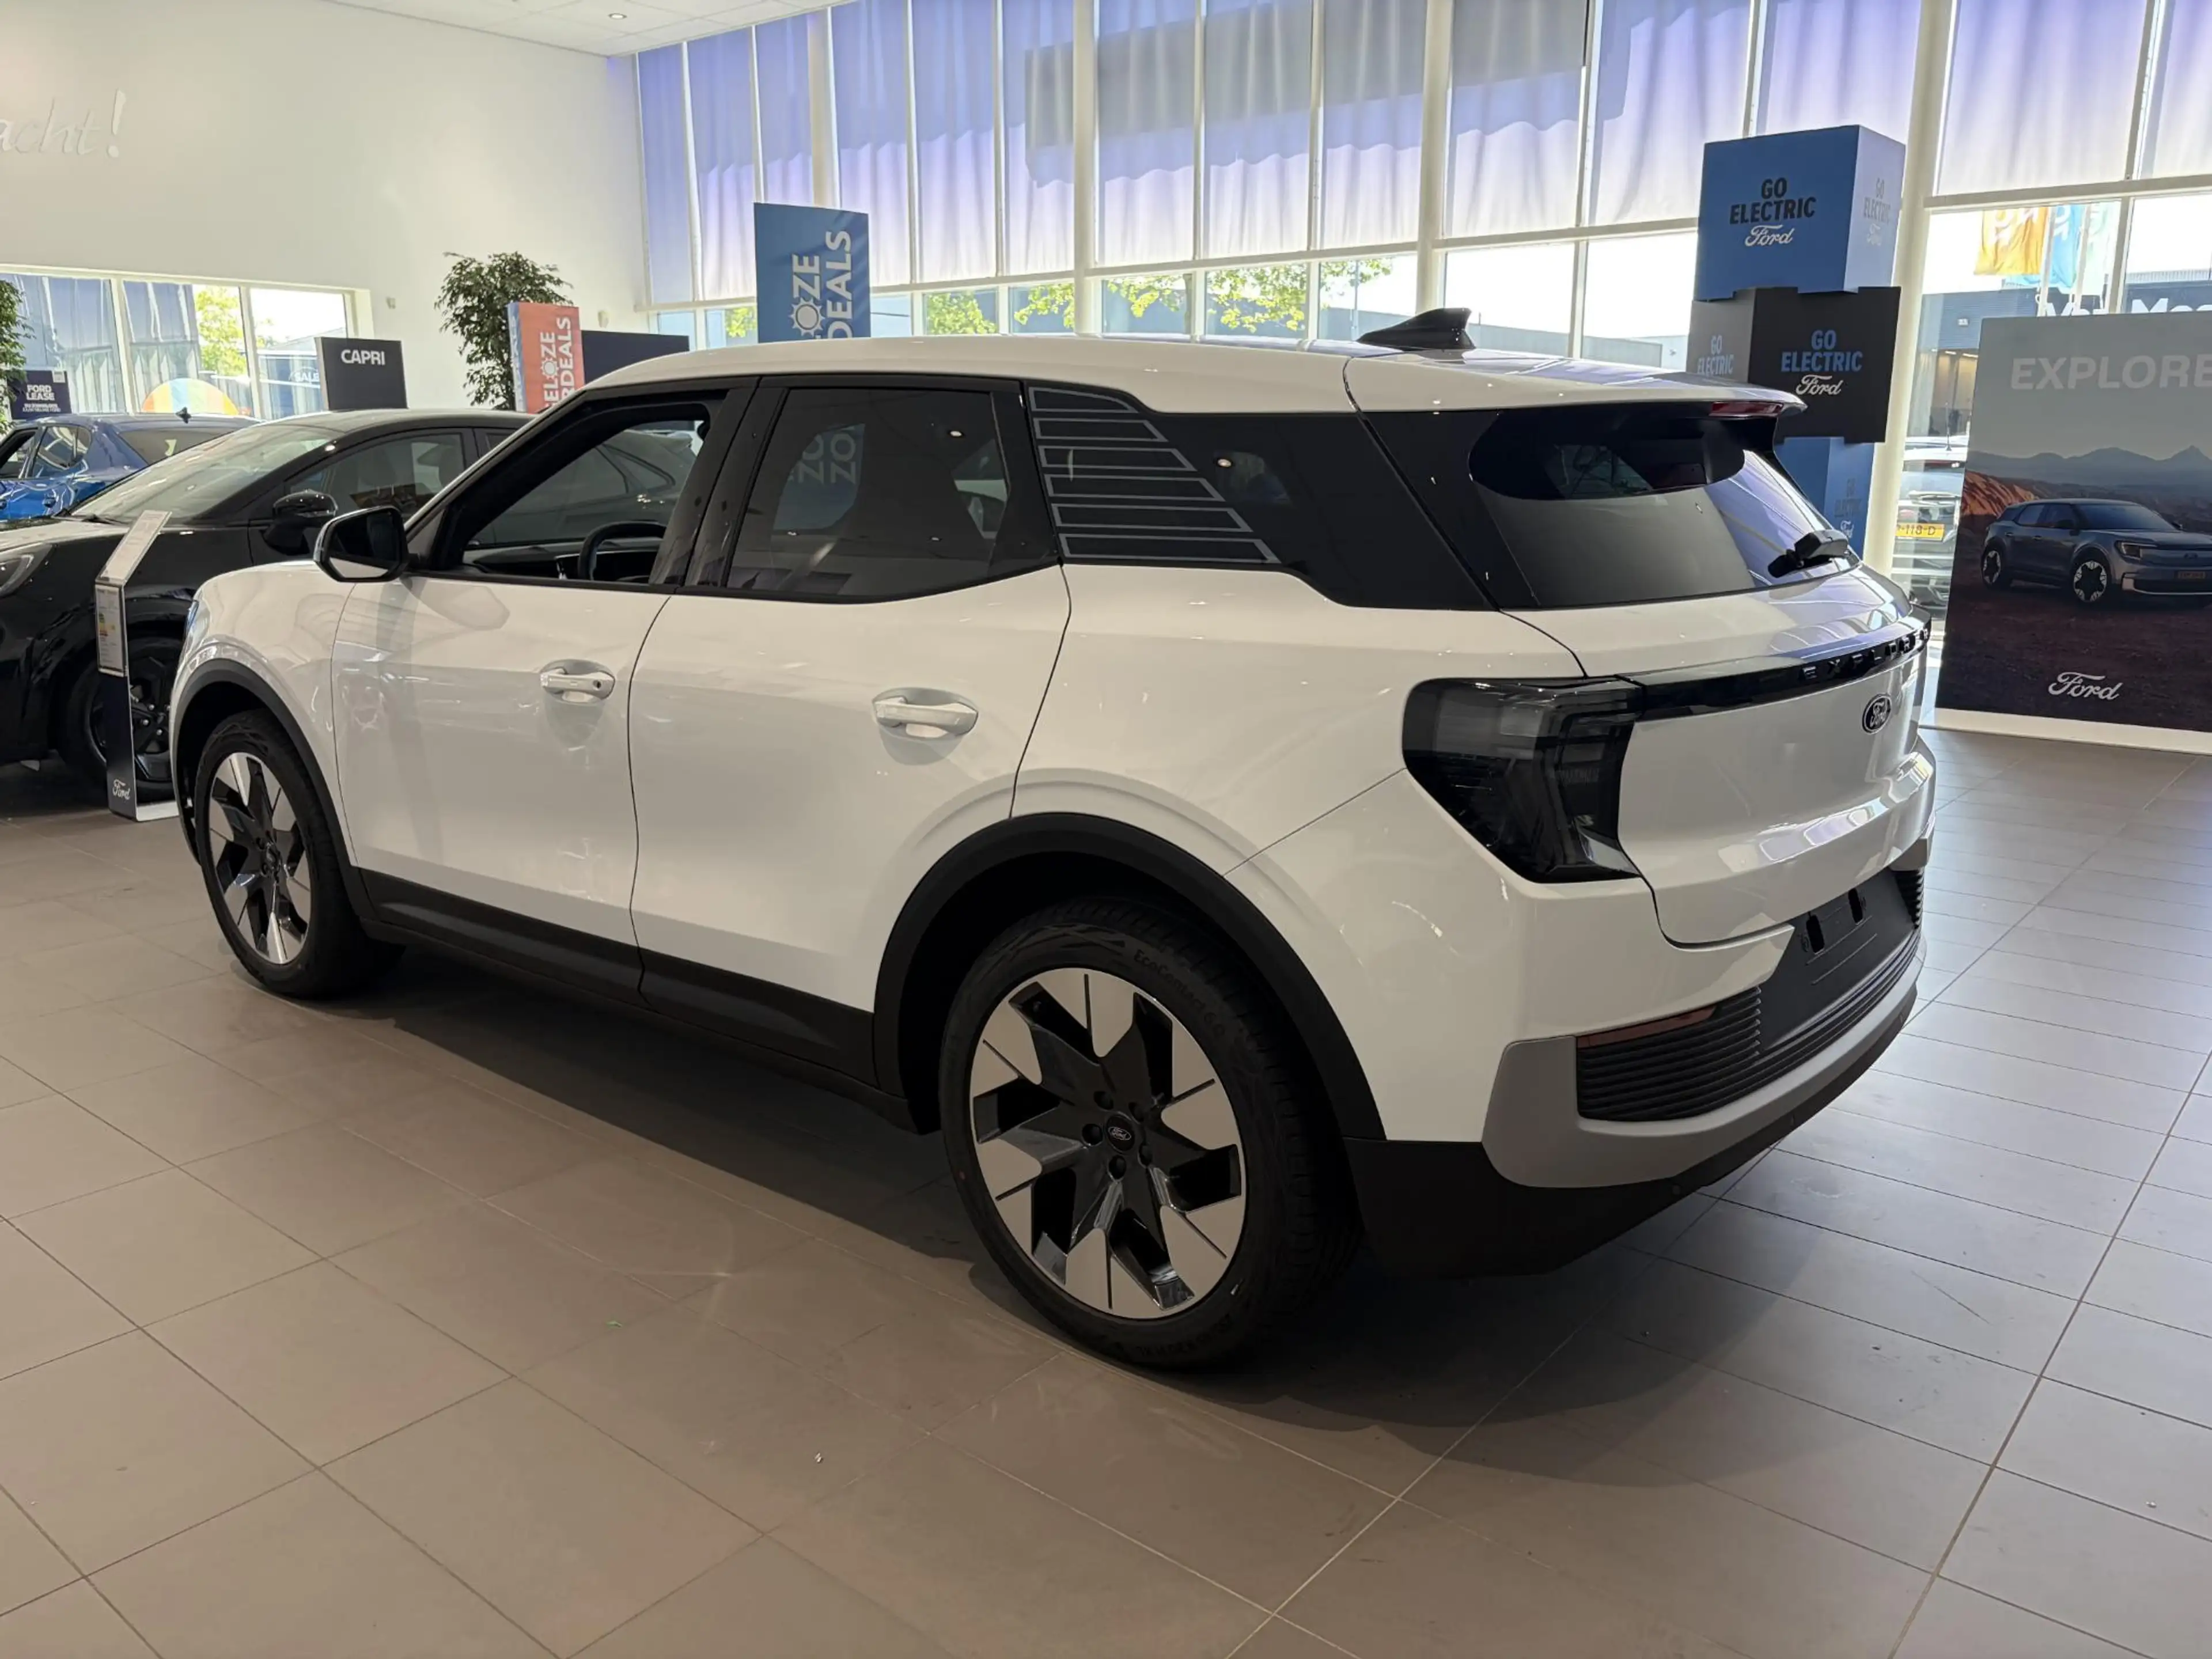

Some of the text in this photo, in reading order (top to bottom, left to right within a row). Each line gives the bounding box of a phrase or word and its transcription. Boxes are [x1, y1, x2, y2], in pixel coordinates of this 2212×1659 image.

[1761, 177, 1787, 199] GO
[1729, 196, 1817, 225] ELECTRIC
[1745, 224, 1795, 247] Ford
[1711, 335, 1722, 355] GO
[1811, 329, 1836, 350] GO
[340, 349, 385, 365] CAPRI
[1696, 354, 1734, 377] ELECTRIC
[1781, 351, 1863, 372] ELECTRIC
[2010, 354, 2212, 389] EXPLORE
[26, 384, 52, 392] FORD
[1796, 374, 1844, 395] Ford
[26, 392, 55, 401] LEASE
[2048, 671, 2123, 700] Ford
[112, 779, 131, 800] Ford
